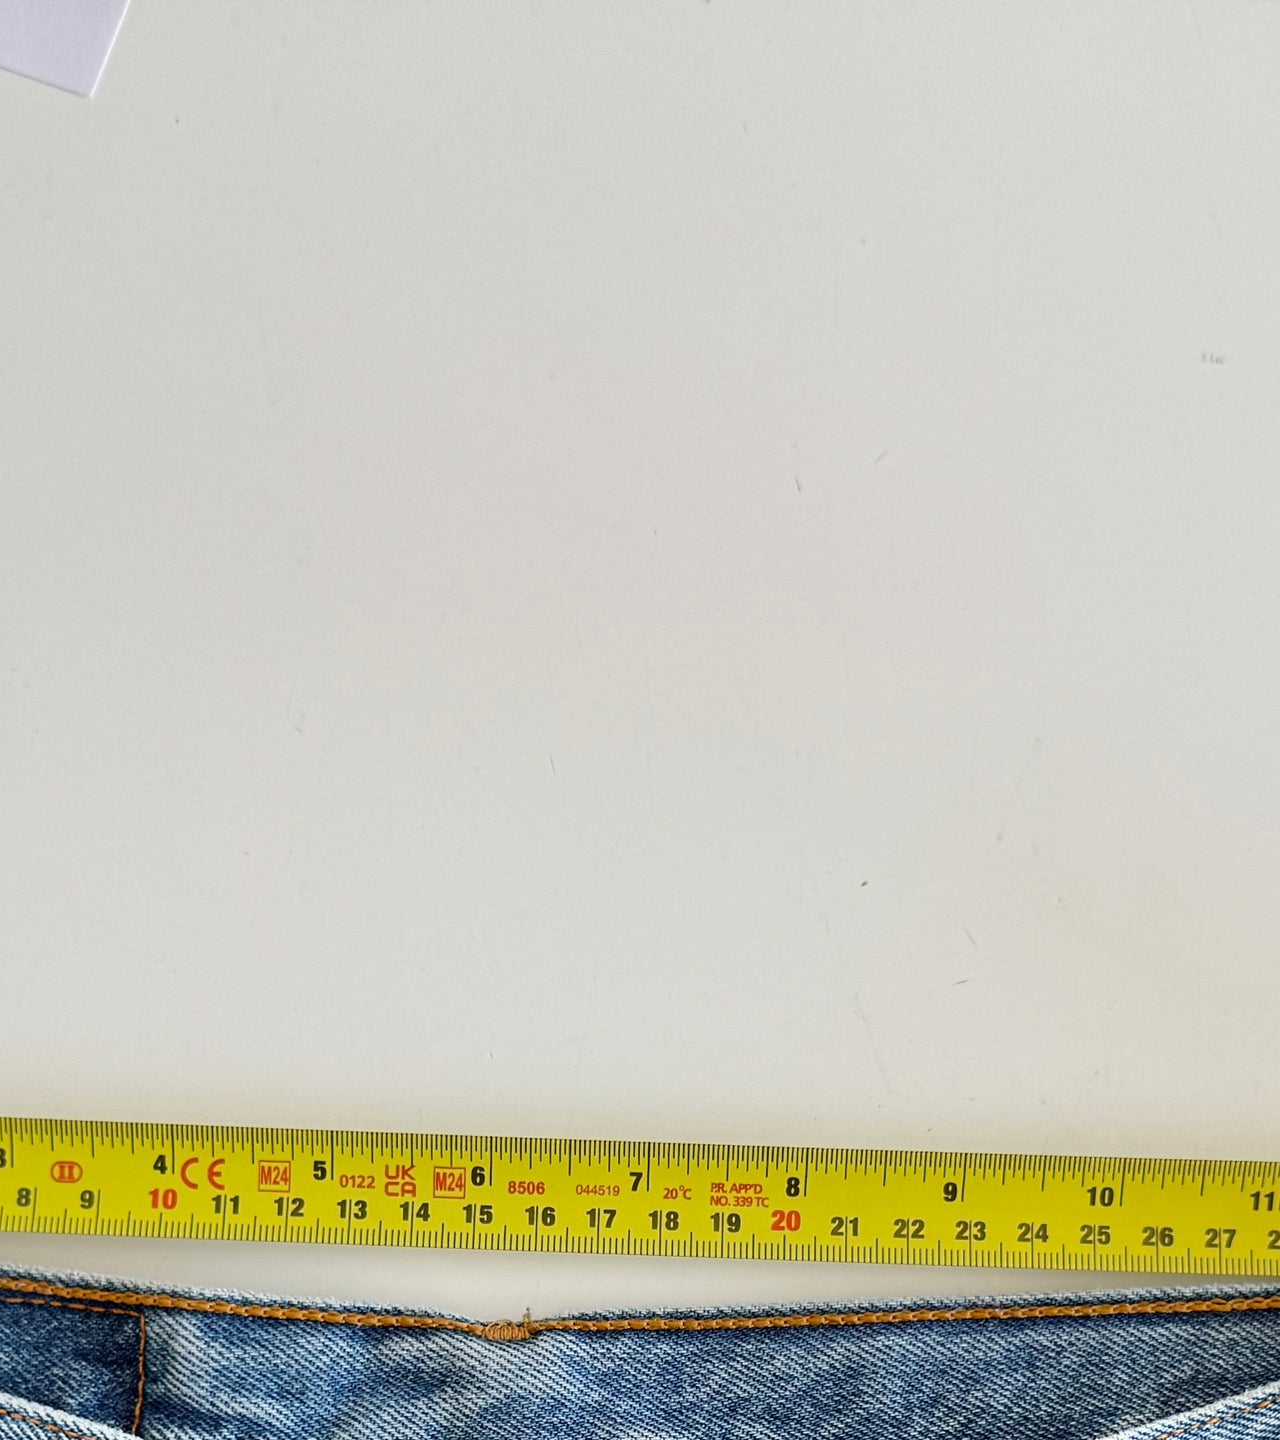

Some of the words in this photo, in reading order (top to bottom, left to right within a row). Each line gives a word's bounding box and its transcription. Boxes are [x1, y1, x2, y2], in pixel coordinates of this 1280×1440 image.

[261, 1166, 289, 1186] M24
[385, 1165, 416, 1181] UK
[153, 1155, 168, 1174] 4
[313, 1161, 327, 1181] 5
[471, 1166, 486, 1186] 6
[629, 1172, 643, 1192] 7
[786, 1177, 800, 1197] 8
[943, 1182, 958, 1203] 9
[1087, 1187, 1114, 1207] 10
[1250, 1191, 1275, 1212] 11
[340, 1175, 376, 1189] 0122
[384, 1182, 417, 1197] CA
[435, 1172, 464, 1192] M24
[508, 1181, 545, 1195] 8506
[576, 1184, 620, 1196] 044519
[710, 1196, 731, 1206] NO.
[733, 1196, 753, 1207] 339
[755, 1197, 769, 1207] TC
[17, 1188, 31, 1207] 8
[80, 1190, 94, 1209] 9
[149, 1189, 178, 1209] 10
[212, 1195, 240, 1214] 11
[274, 1197, 305, 1217] 12
[337, 1200, 368, 1220] 13
[400, 1202, 430, 1221] 14
[463, 1204, 493, 1224] 15
[525, 1207, 556, 1226] 16
[586, 1209, 617, 1228] 17
[648, 1211, 679, 1230] 18
[710, 1213, 741, 1233] 19
[771, 1210, 801, 1231] 20
[830, 1217, 859, 1237] 21
[893, 1219, 925, 1239] 22
[955, 1221, 987, 1241] 23
[1017, 1223, 1049, 1243] 24
[1080, 1225, 1111, 1245] 25
[1142, 1226, 1174, 1247] 26
[1205, 1228, 1237, 1249] 27
